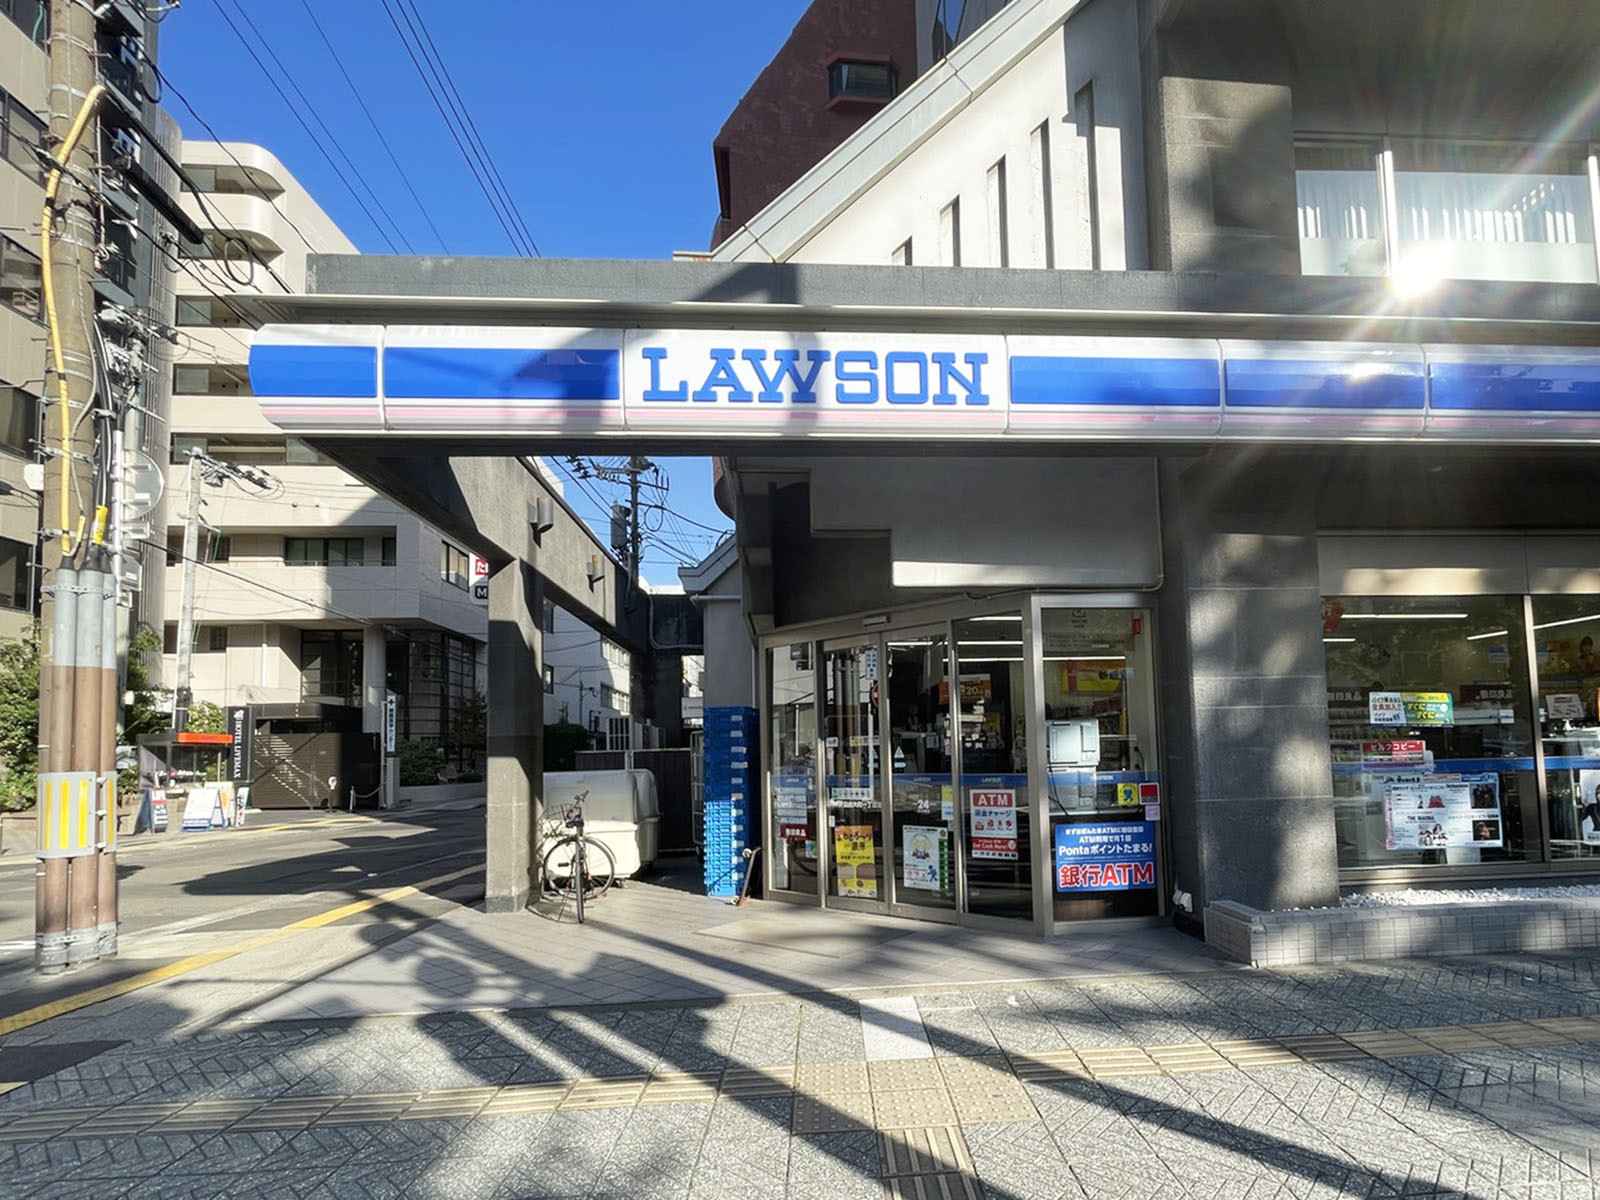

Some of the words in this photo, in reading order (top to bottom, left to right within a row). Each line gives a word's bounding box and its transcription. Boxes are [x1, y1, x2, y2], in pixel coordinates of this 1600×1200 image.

[642, 347, 989, 405] LAWSON
[1370, 743, 1416, 751] セルフコピー
[978, 794, 1008, 806] ATM
[1060, 862, 1154, 888] 銀行ATM
